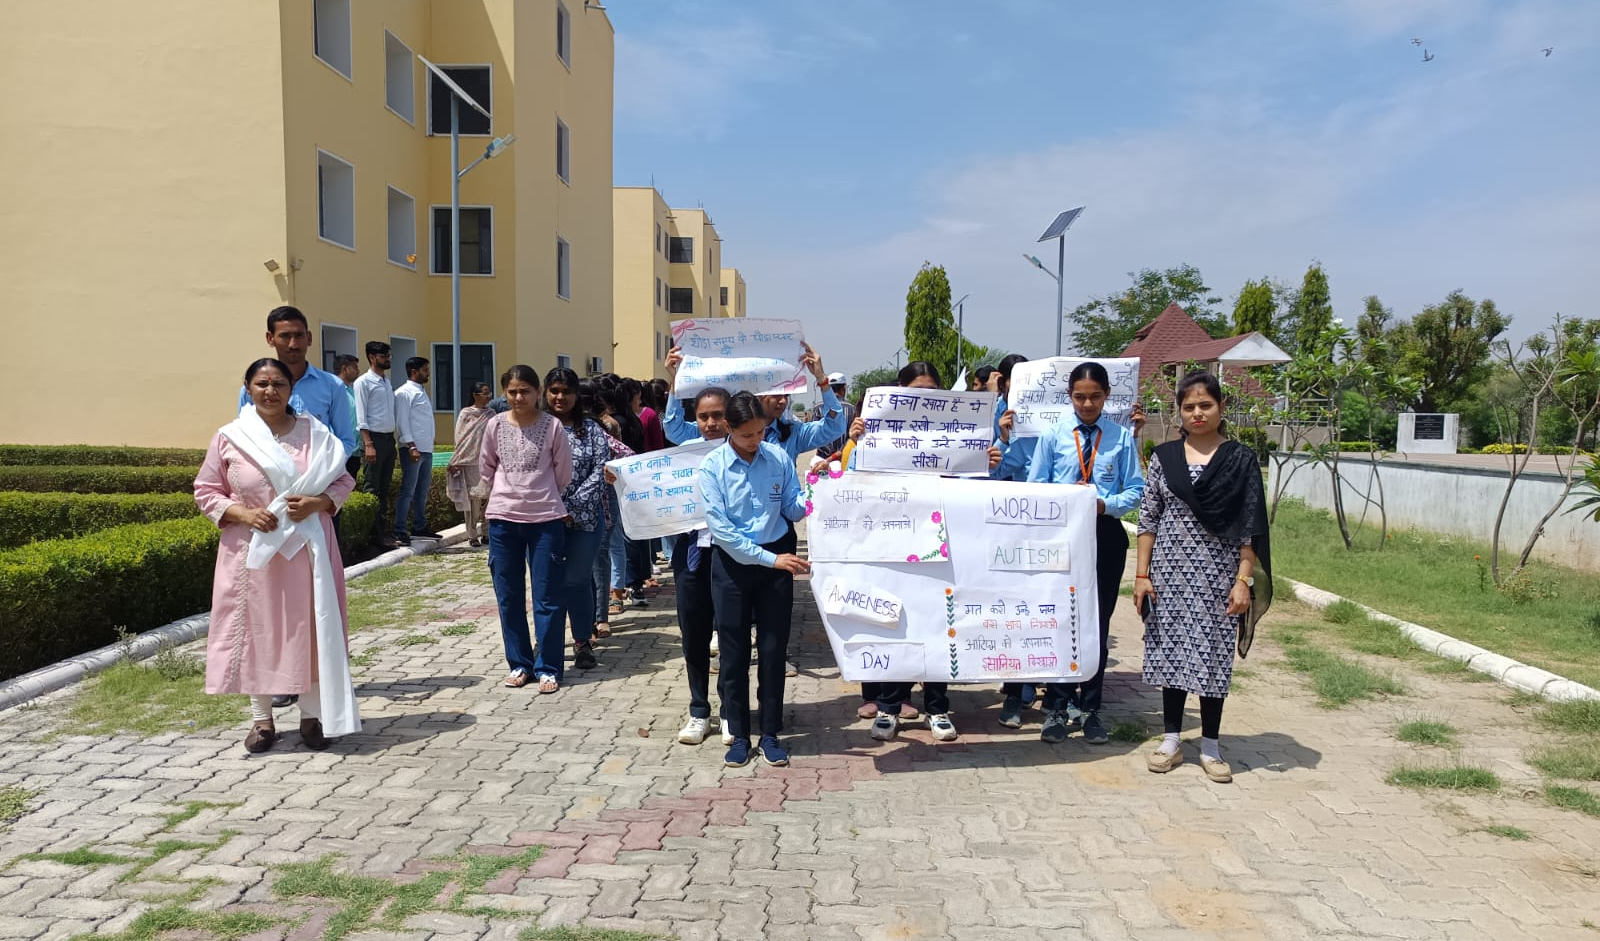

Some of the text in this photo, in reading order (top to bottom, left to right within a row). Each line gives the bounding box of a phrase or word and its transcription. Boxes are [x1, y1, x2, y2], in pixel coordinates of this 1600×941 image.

[922, 398, 948, 411] खास
[1040, 411, 1061, 423] प्यार
[865, 436, 882, 448] को
[912, 452, 942, 468] सीखो
[991, 497, 1062, 521] WORLD
[863, 514, 874, 530] को
[994, 545, 1060, 565] AUTISM
[827, 584, 899, 619] AWARENESS
[861, 651, 890, 670] DAY
